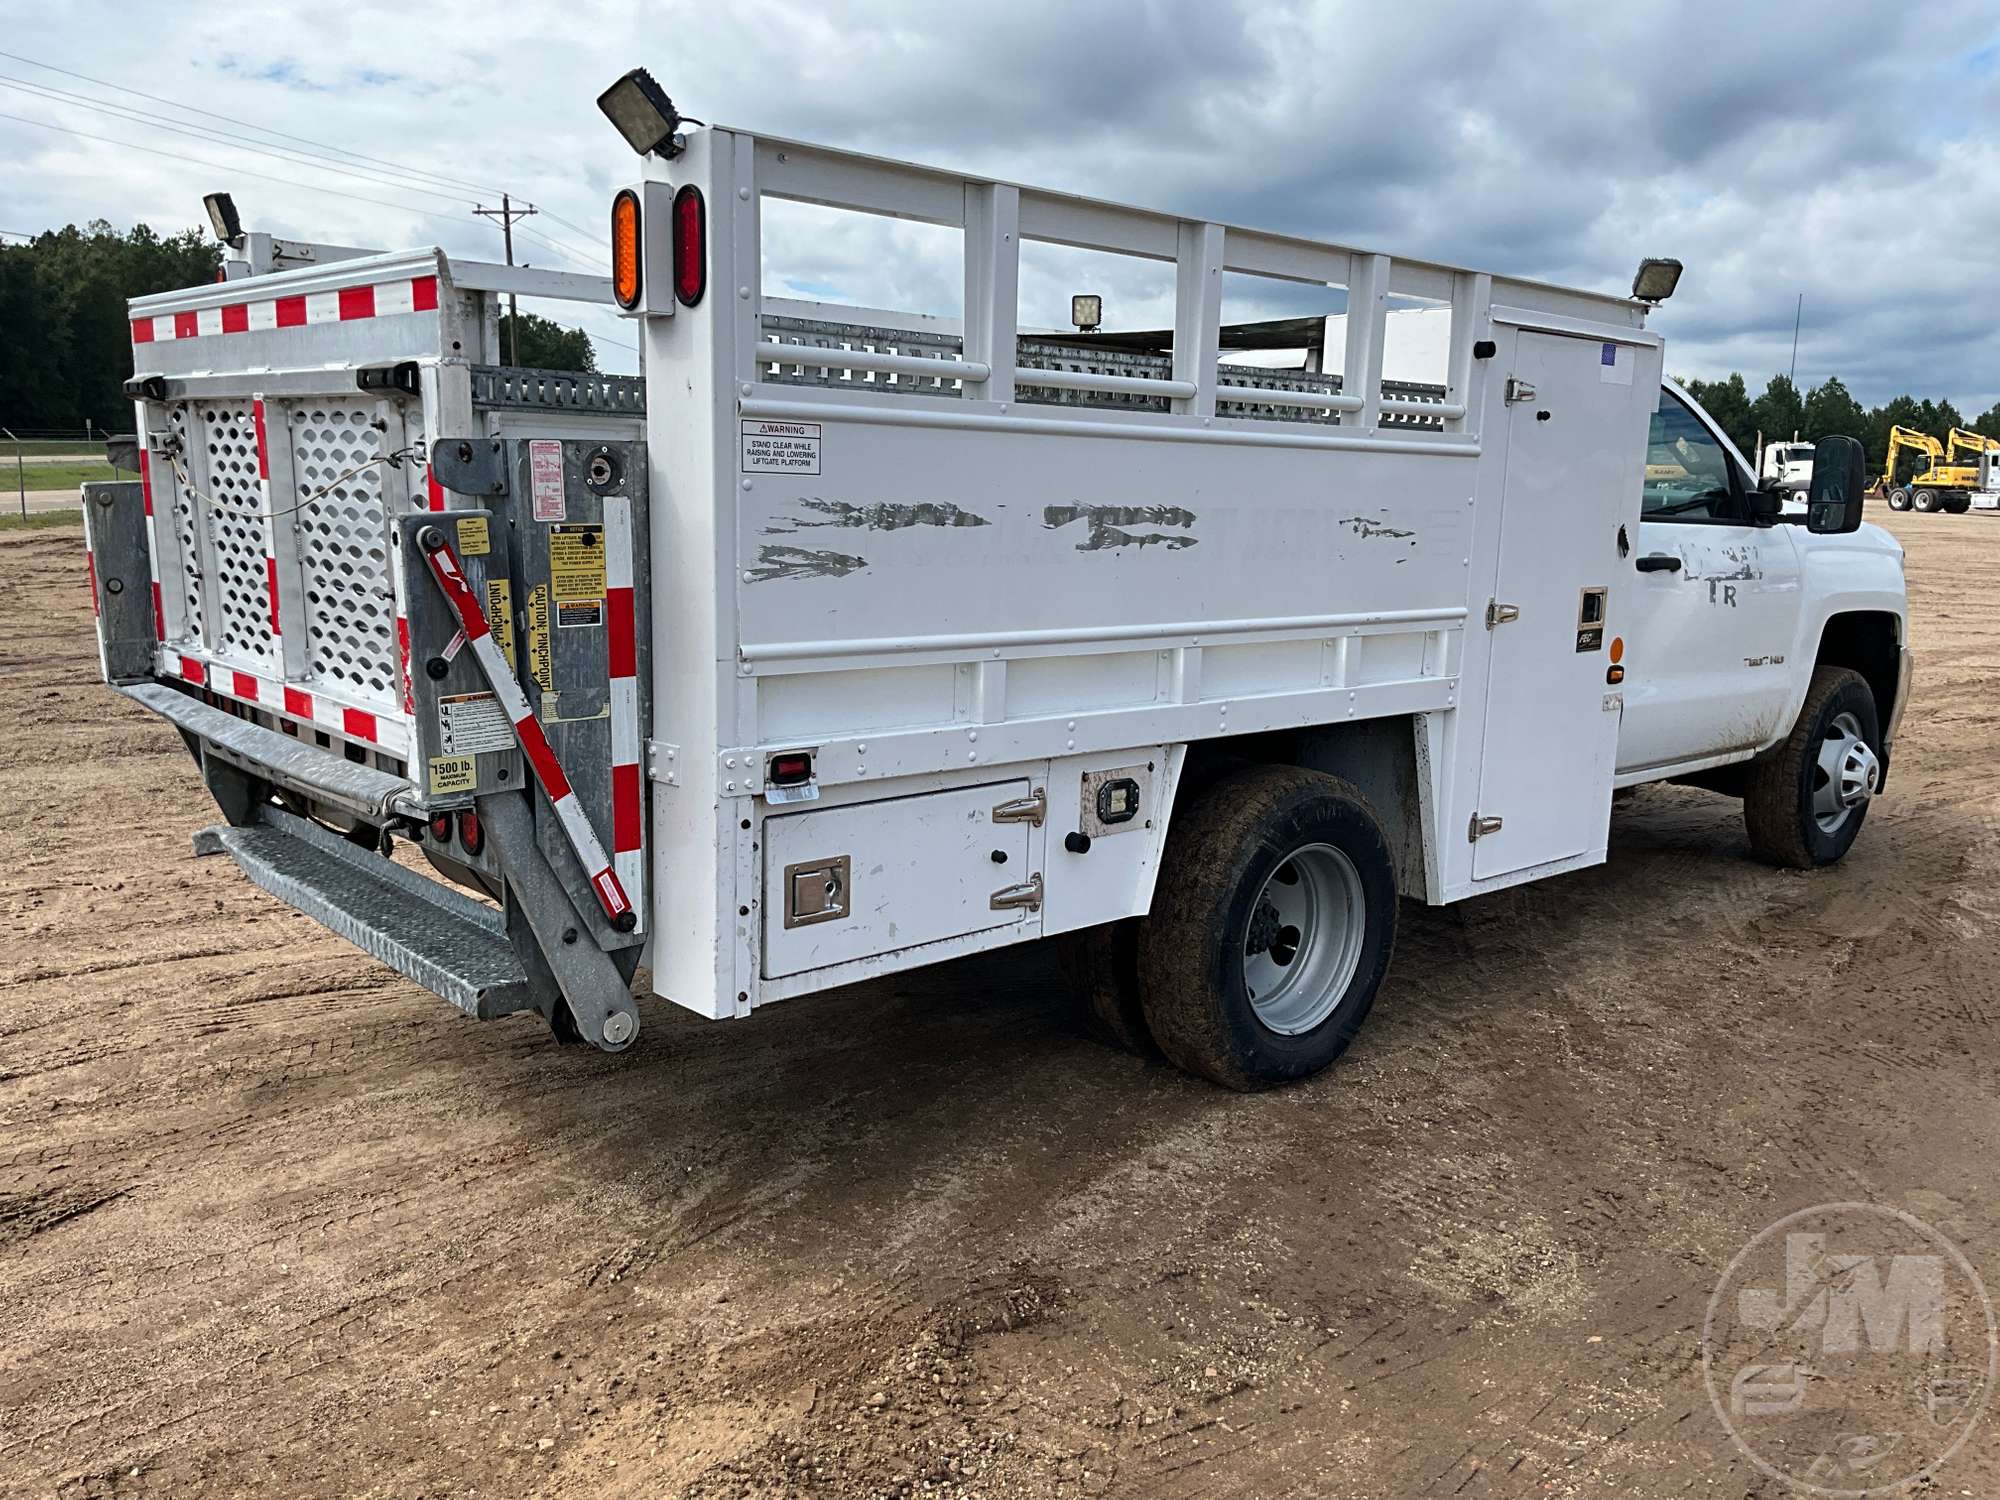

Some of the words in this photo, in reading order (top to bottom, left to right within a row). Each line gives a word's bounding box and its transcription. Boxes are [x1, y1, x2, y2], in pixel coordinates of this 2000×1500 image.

[767, 425, 805, 435] WARNING
[752, 441, 771, 449] STAND
[794, 443, 812, 451] WHILE
[746, 449, 771, 457] RAISING
[772, 450, 785, 458] AND
[786, 451, 817, 459] LOWERING
[752, 458, 780, 466] LIFTGATE
[781, 459, 811, 467] PLATFORM
[489, 582, 504, 640] PINCHPOINT
[535, 586, 547, 631] CAUTION:
[537, 633, 551, 689] PINCHPOINT
[433, 761, 458, 775] 1500
[460, 760, 473, 772] lb.
[440, 772, 467, 780] MAXIMUM
[437, 779, 470, 788] CAPACITY
